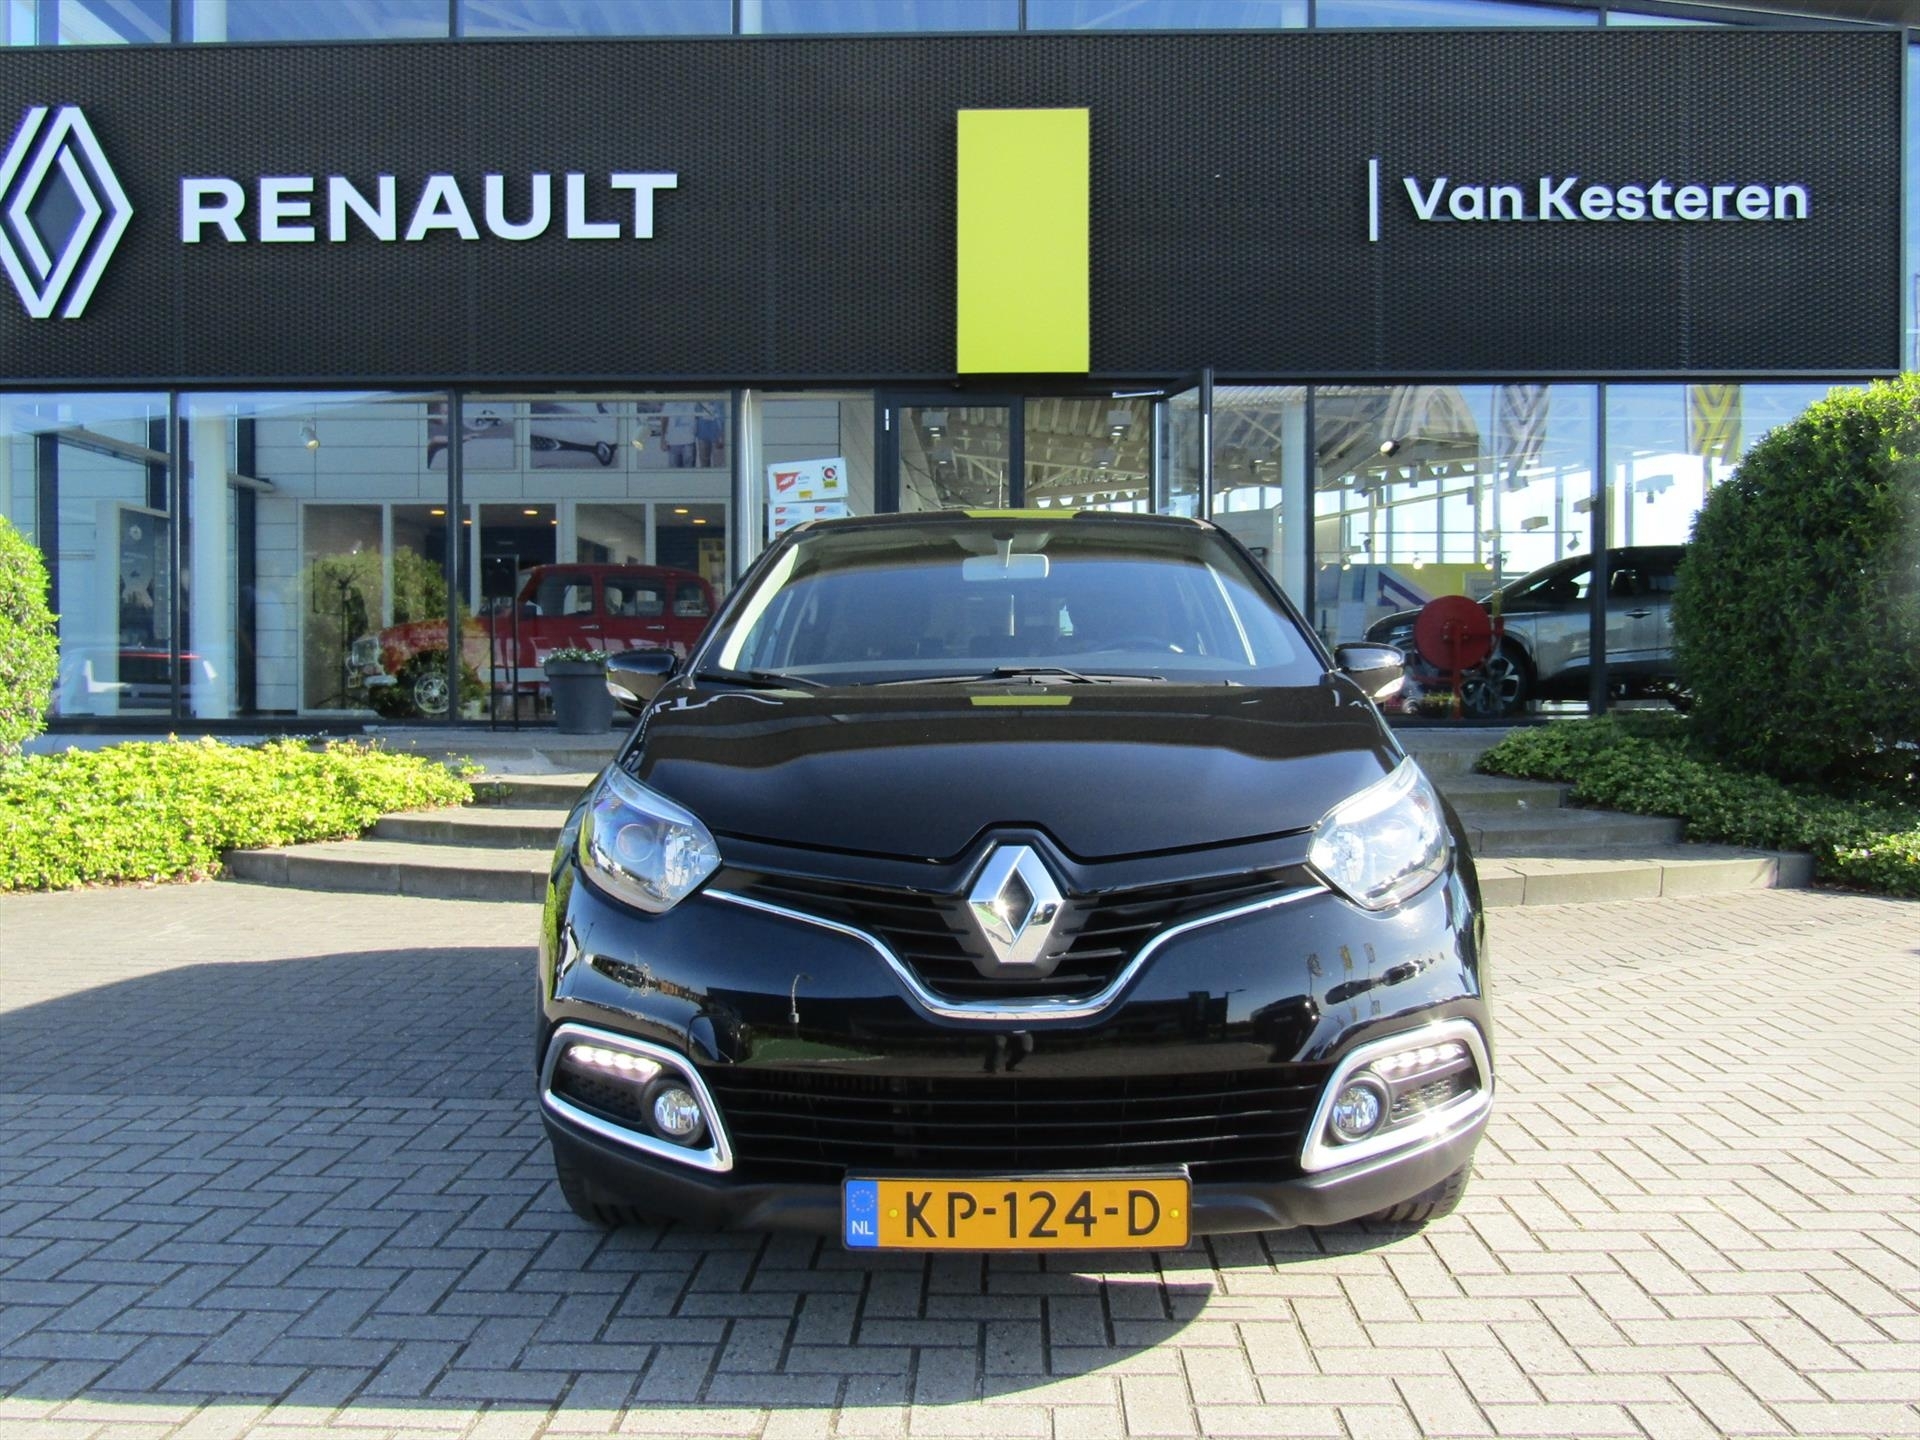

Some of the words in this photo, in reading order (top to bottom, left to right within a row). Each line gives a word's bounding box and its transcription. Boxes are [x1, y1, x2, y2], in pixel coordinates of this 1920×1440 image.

[181, 173, 678, 243] RENAULT
[1403, 177, 1523, 221] Van
[1538, 177, 1808, 221] Kesteren
[851, 1219, 874, 1236] NL
[905, 1189, 1161, 1238] KP-124-D
